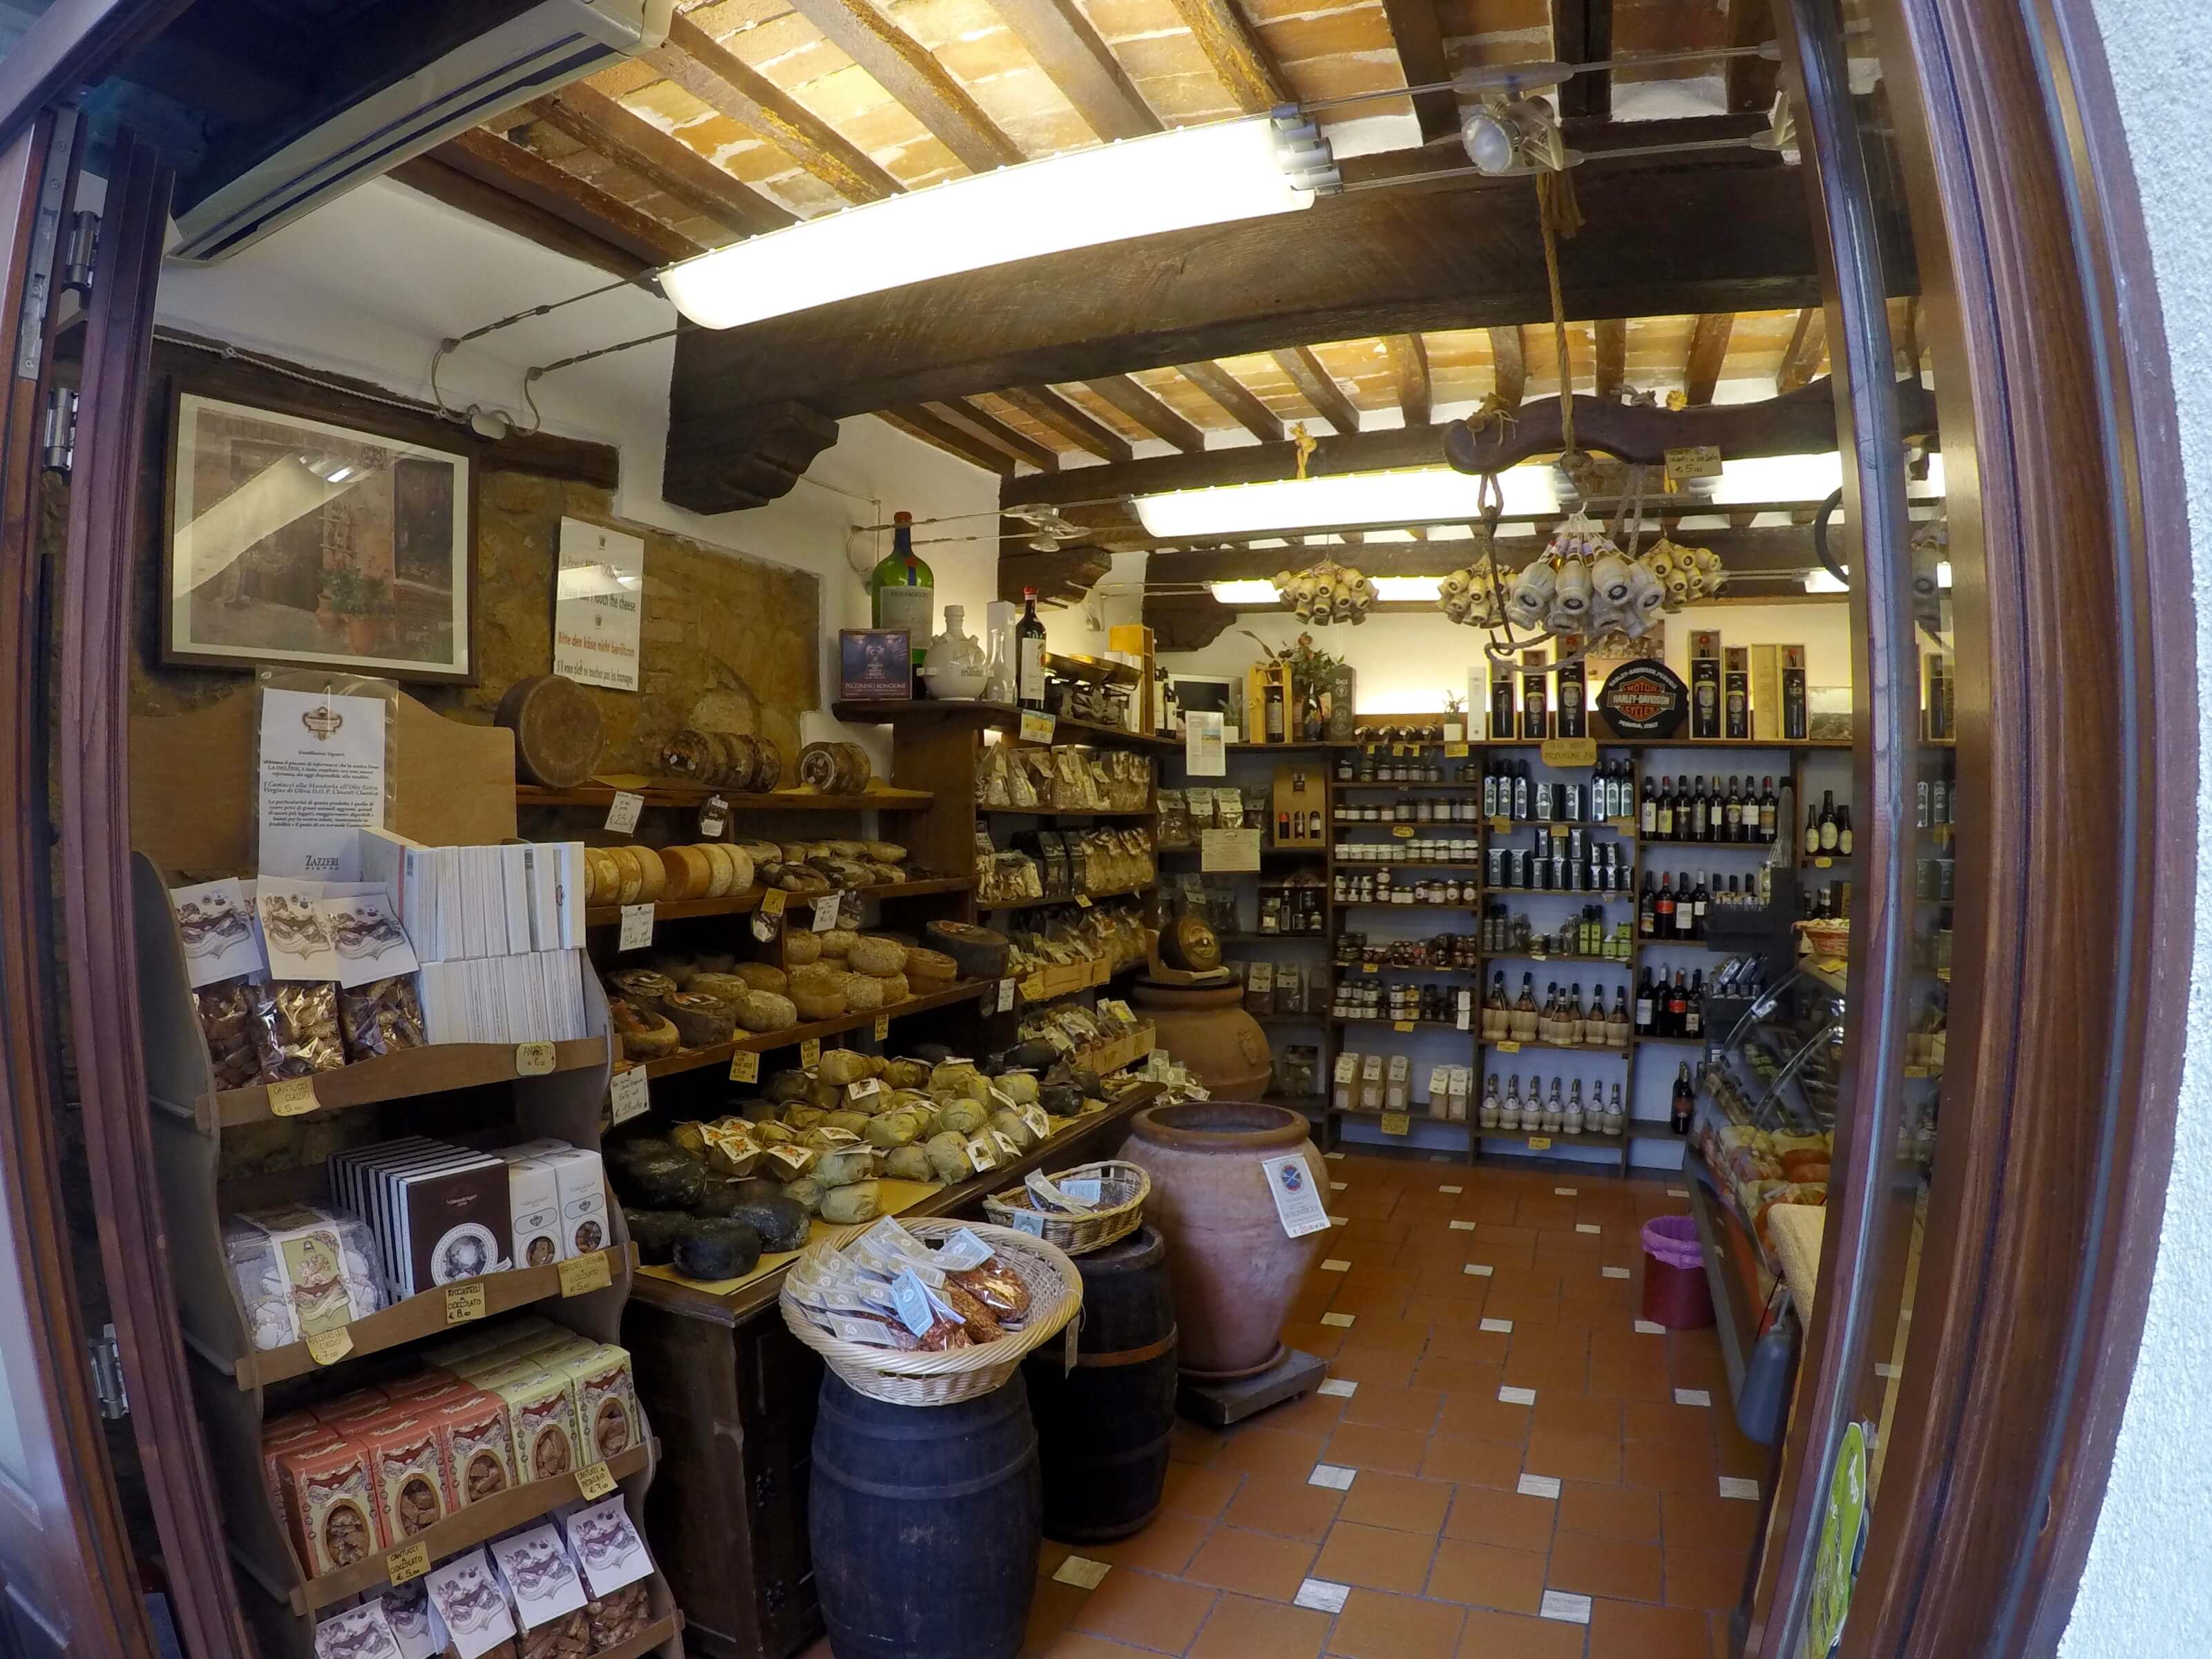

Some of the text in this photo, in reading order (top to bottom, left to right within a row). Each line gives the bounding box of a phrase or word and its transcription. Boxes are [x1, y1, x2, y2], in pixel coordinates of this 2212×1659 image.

[610, 594, 618, 609] the
[619, 594, 636, 612] cheese
[558, 632, 571, 645] Bitte
[571, 634, 582, 647] den
[564, 665, 573, 674] vous
[1626, 681, 1658, 692] MOTOR
[1612, 694, 1670, 705] HARLEY-DAVIDSON
[305, 855, 339, 867] ZAZZERI
[273, 1083, 308, 1095] CANTUCCI
[390, 1544, 419, 1562] CANTUCCI
